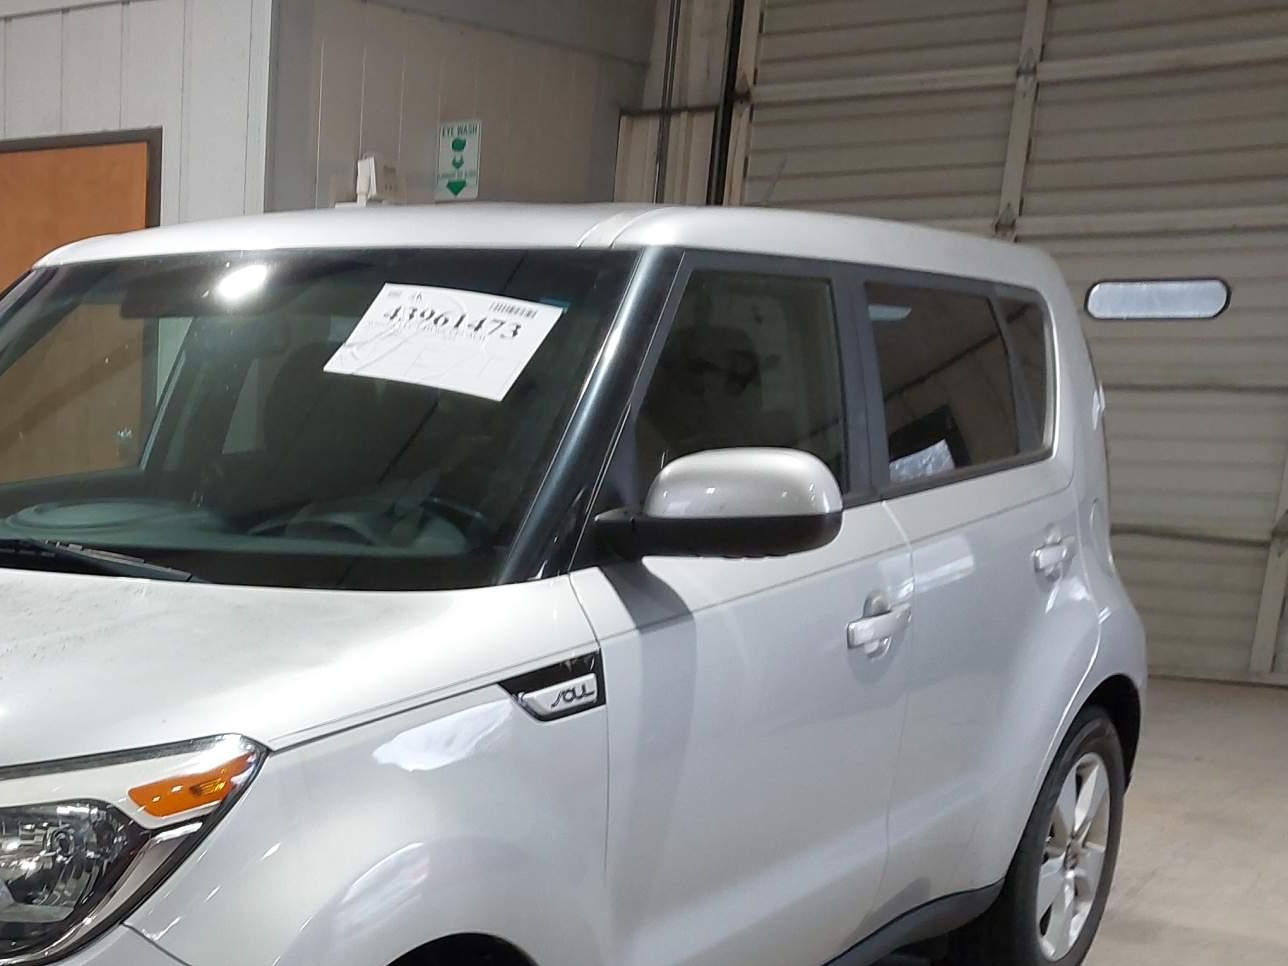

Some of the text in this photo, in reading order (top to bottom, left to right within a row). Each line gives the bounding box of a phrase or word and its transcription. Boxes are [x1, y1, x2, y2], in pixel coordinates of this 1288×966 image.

[457, 123, 478, 136] WASH
[383, 304, 522, 339] 43961473
[551, 684, 595, 708] SOUL
